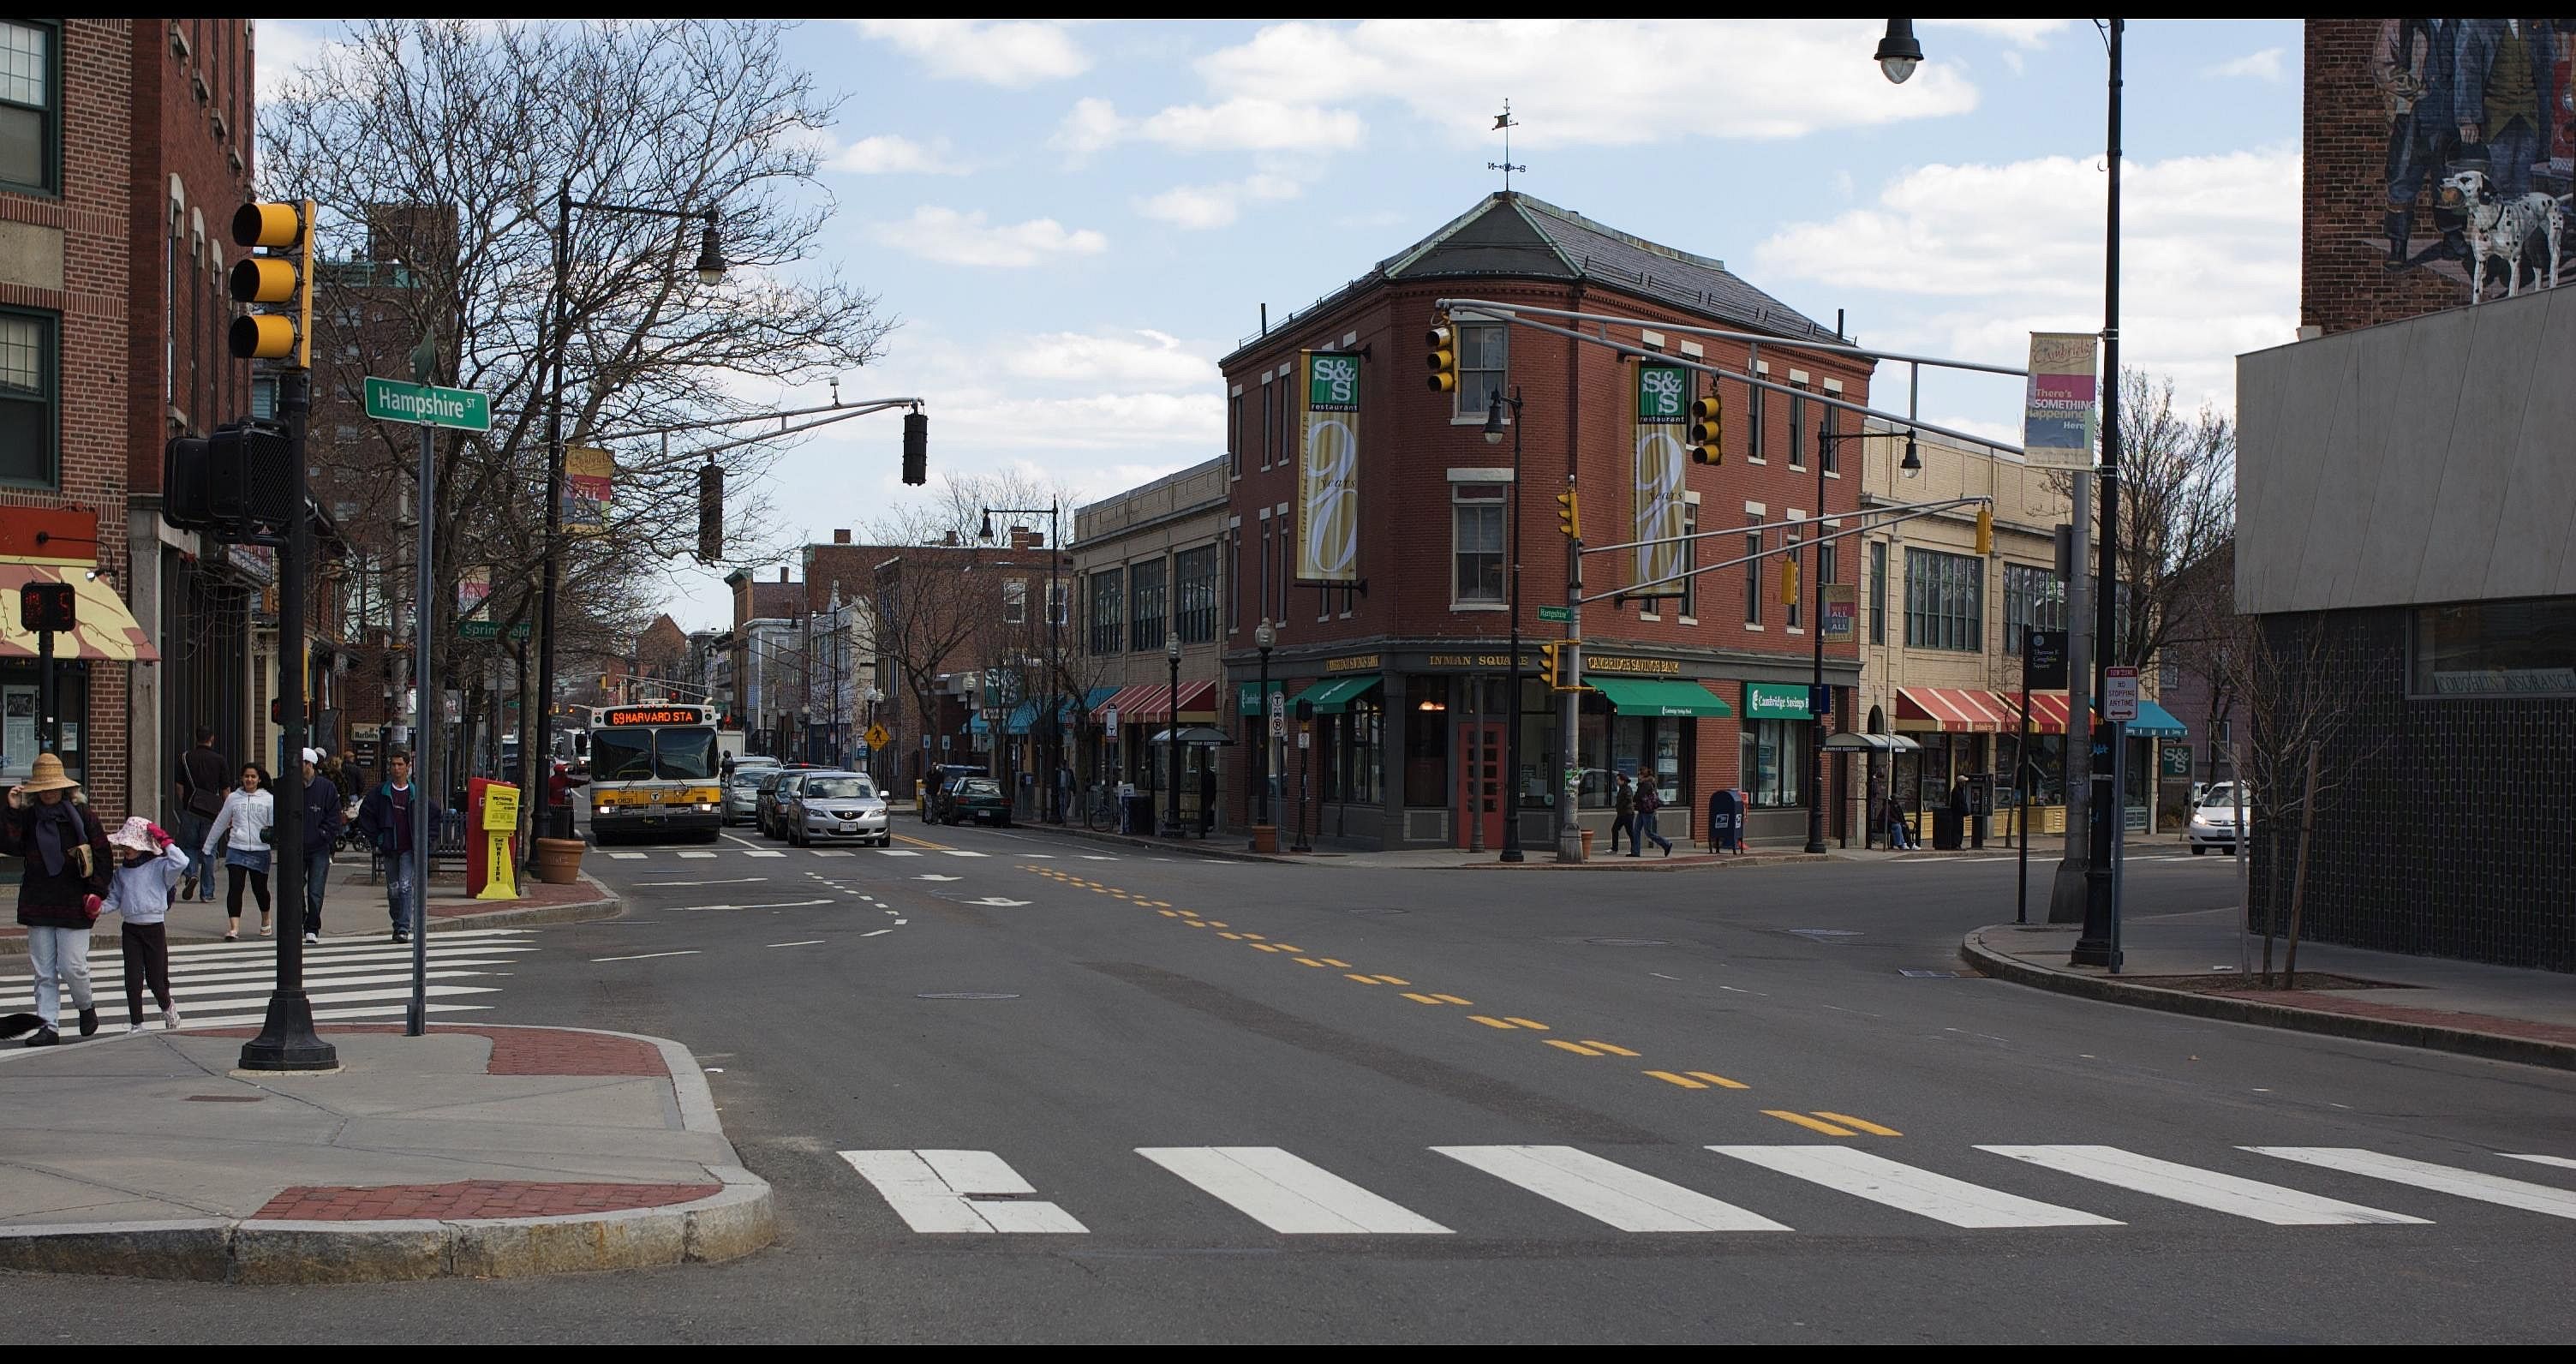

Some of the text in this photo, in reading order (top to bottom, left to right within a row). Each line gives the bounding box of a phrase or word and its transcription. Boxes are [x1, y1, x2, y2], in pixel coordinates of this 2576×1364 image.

[2035, 388, 2072, 398] There's
[379, 386, 475, 419] Hampshire ST
[2035, 398, 2096, 411] SOMETHING
[2063, 421, 2085, 430] Here
[1319, 478, 1356, 492] years
[1649, 491, 1683, 502] years
[465, 624, 529, 637] Sprineld
[1430, 655, 1529, 666] INMAN SQUAE
[1588, 657, 1679, 673] CAMBRIDGE SAVINGS BANK
[2501, 672, 2576, 693] INSURANCE
[1759, 695, 1786, 709] Cambridge
[1786, 696, 1804, 710] Savings
[613, 711, 693, 725] 69 HARVARD STA
